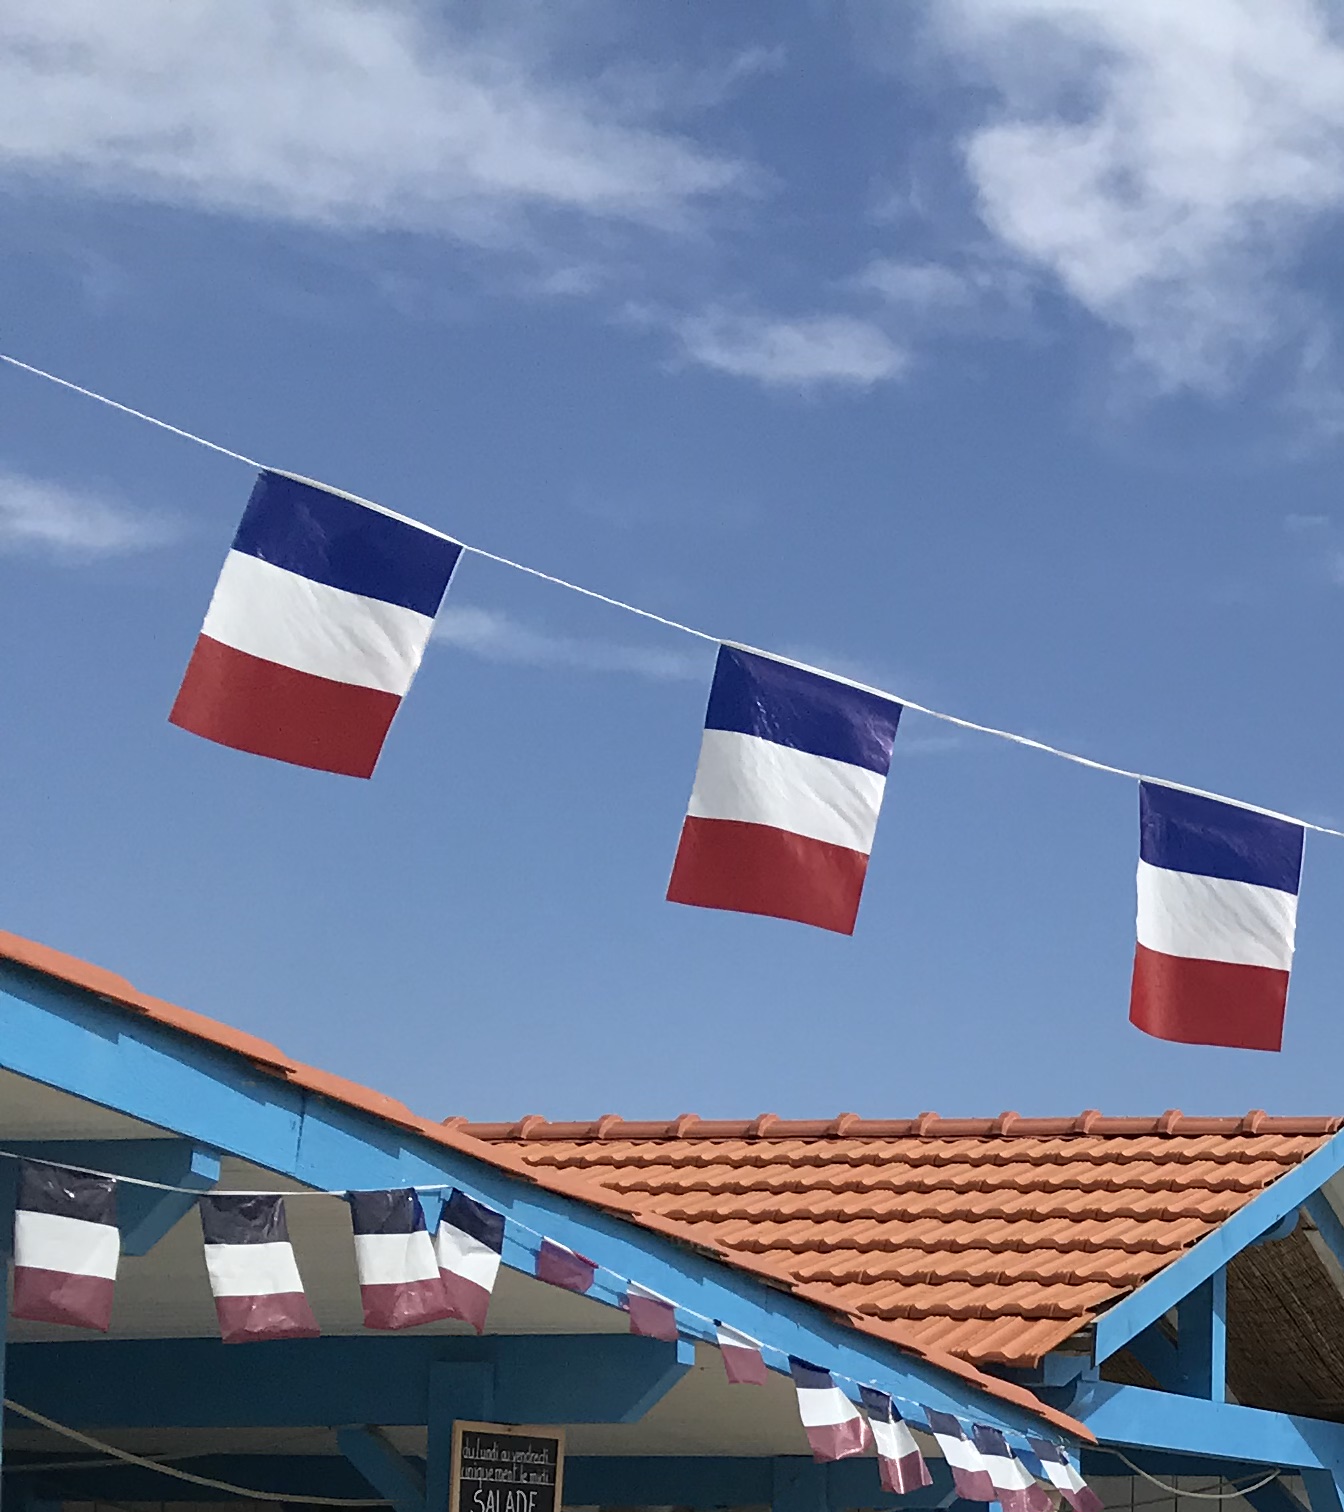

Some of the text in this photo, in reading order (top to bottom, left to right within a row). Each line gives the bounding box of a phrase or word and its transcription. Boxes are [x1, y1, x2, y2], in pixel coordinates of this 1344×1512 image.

[463, 1437, 549, 1465] du lundi au vendredi
[461, 1462, 517, 1489] uniquement
[520, 1464, 528, 1484] le
